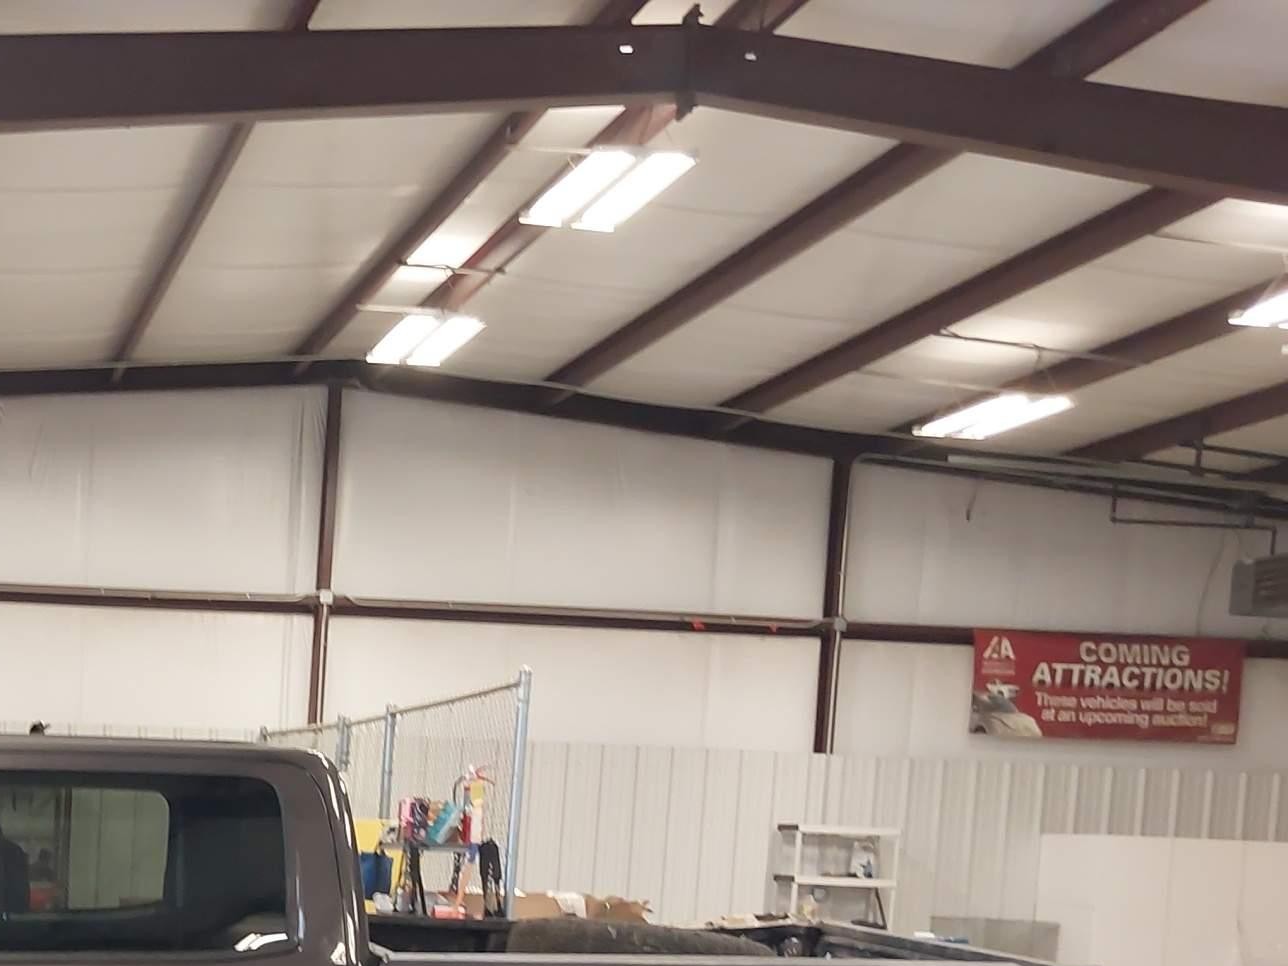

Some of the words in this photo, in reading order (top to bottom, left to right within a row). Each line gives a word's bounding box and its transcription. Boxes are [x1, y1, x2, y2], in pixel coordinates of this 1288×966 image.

[1079, 641, 1190, 666] COMING
[1032, 662, 1230, 694] ATTRACTIONS!
[1035, 691, 1077, 708] These
[1080, 696, 1137, 710] vehicles
[1140, 698, 1164, 711] will
[1166, 699, 1185, 712] be
[1188, 700, 1217, 713] sold
[1041, 708, 1055, 721] at
[1057, 710, 1076, 722] an
[1079, 711, 1149, 728] upcoming
[1152, 713, 1208, 727] auction!
